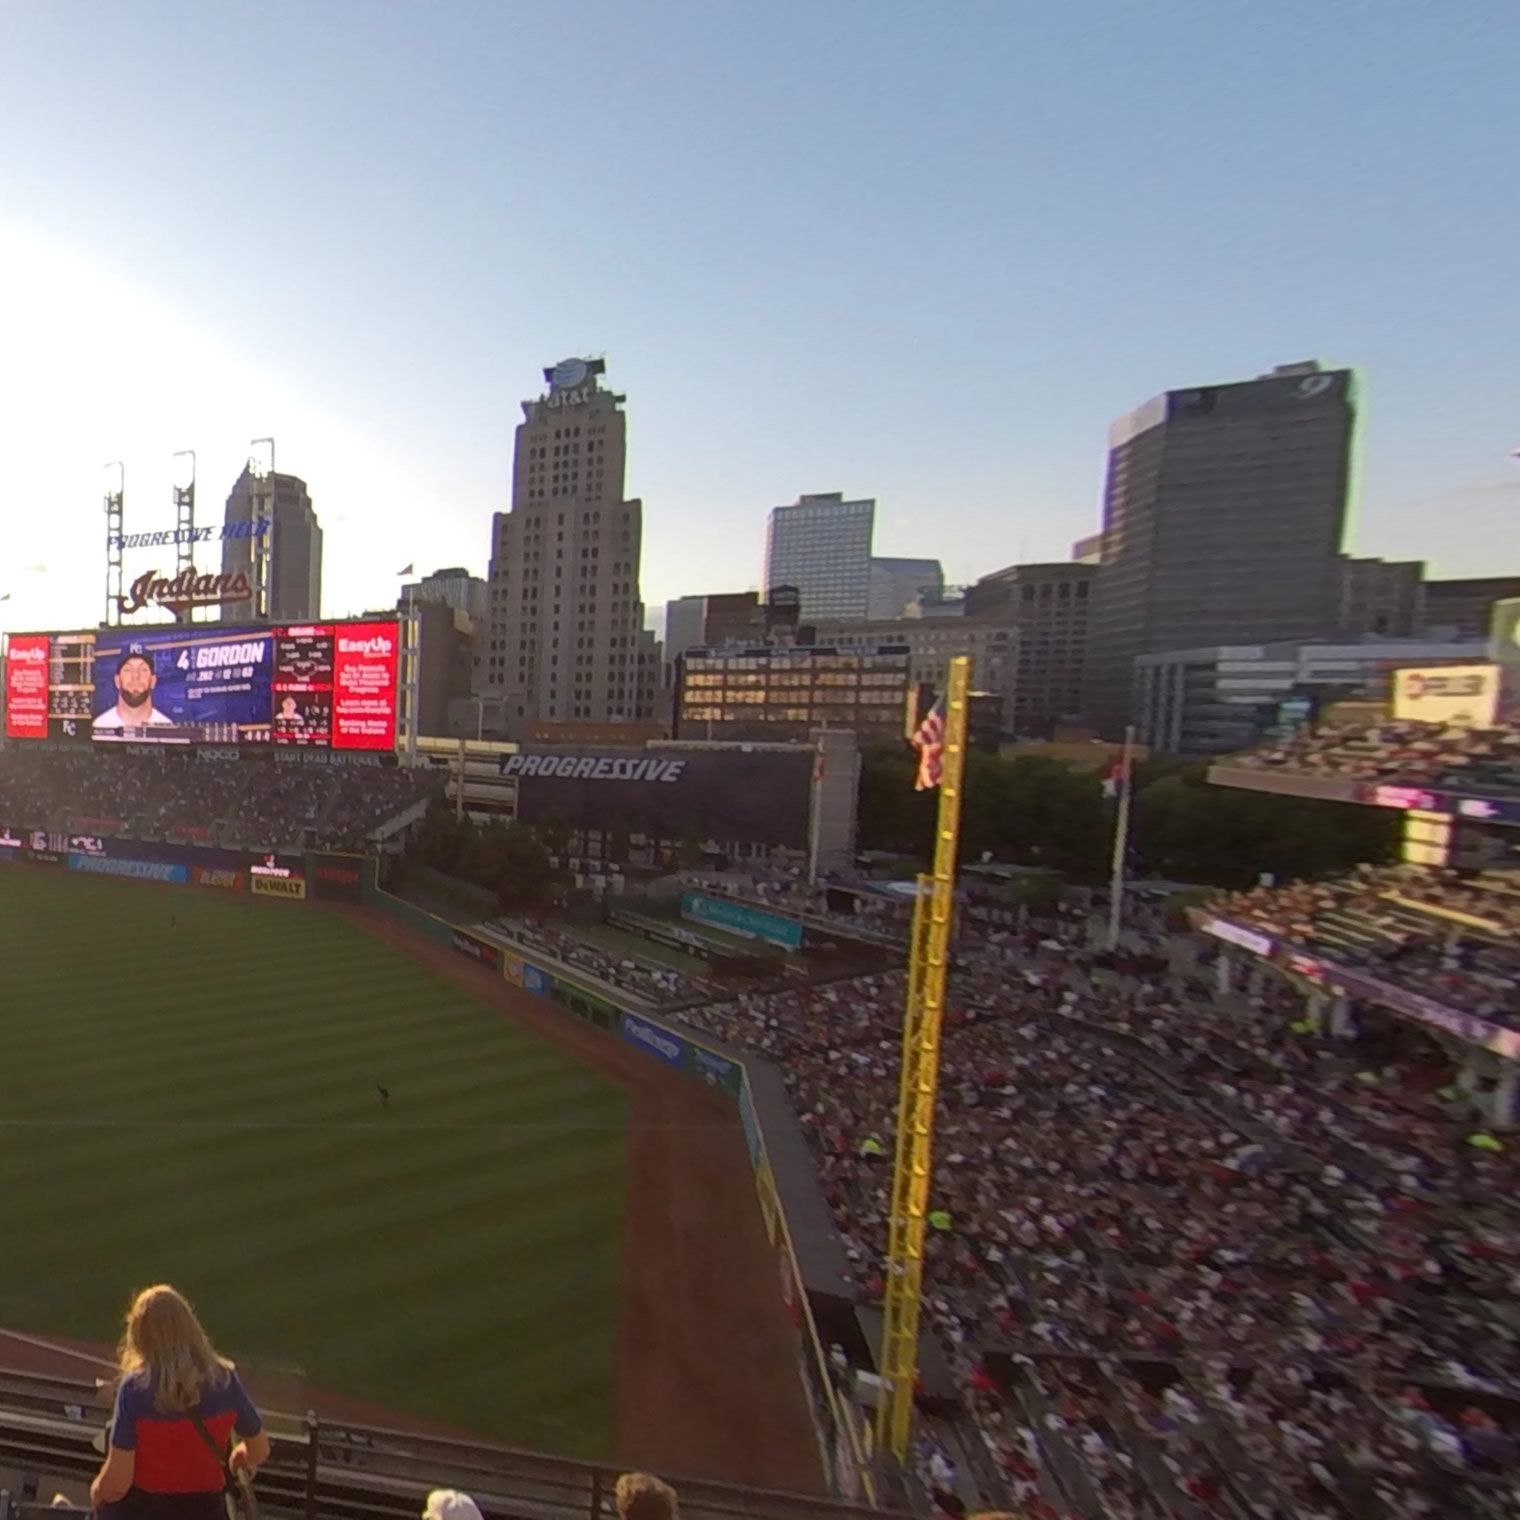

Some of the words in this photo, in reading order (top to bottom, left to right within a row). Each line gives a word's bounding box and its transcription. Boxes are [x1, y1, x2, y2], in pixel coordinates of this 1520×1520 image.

[547, 388, 591, 409] at&t
[107, 525, 216, 550] PROGRESSIVE
[219, 516, 271, 540] FIELD
[118, 566, 252, 614] Indians
[177, 650, 189, 670] 4
[196, 641, 265, 668] GORDON
[338, 637, 392, 654] EasyUp
[503, 755, 686, 783] PROGRESSIVE
[77, 856, 175, 881] PROGRESSIVE
